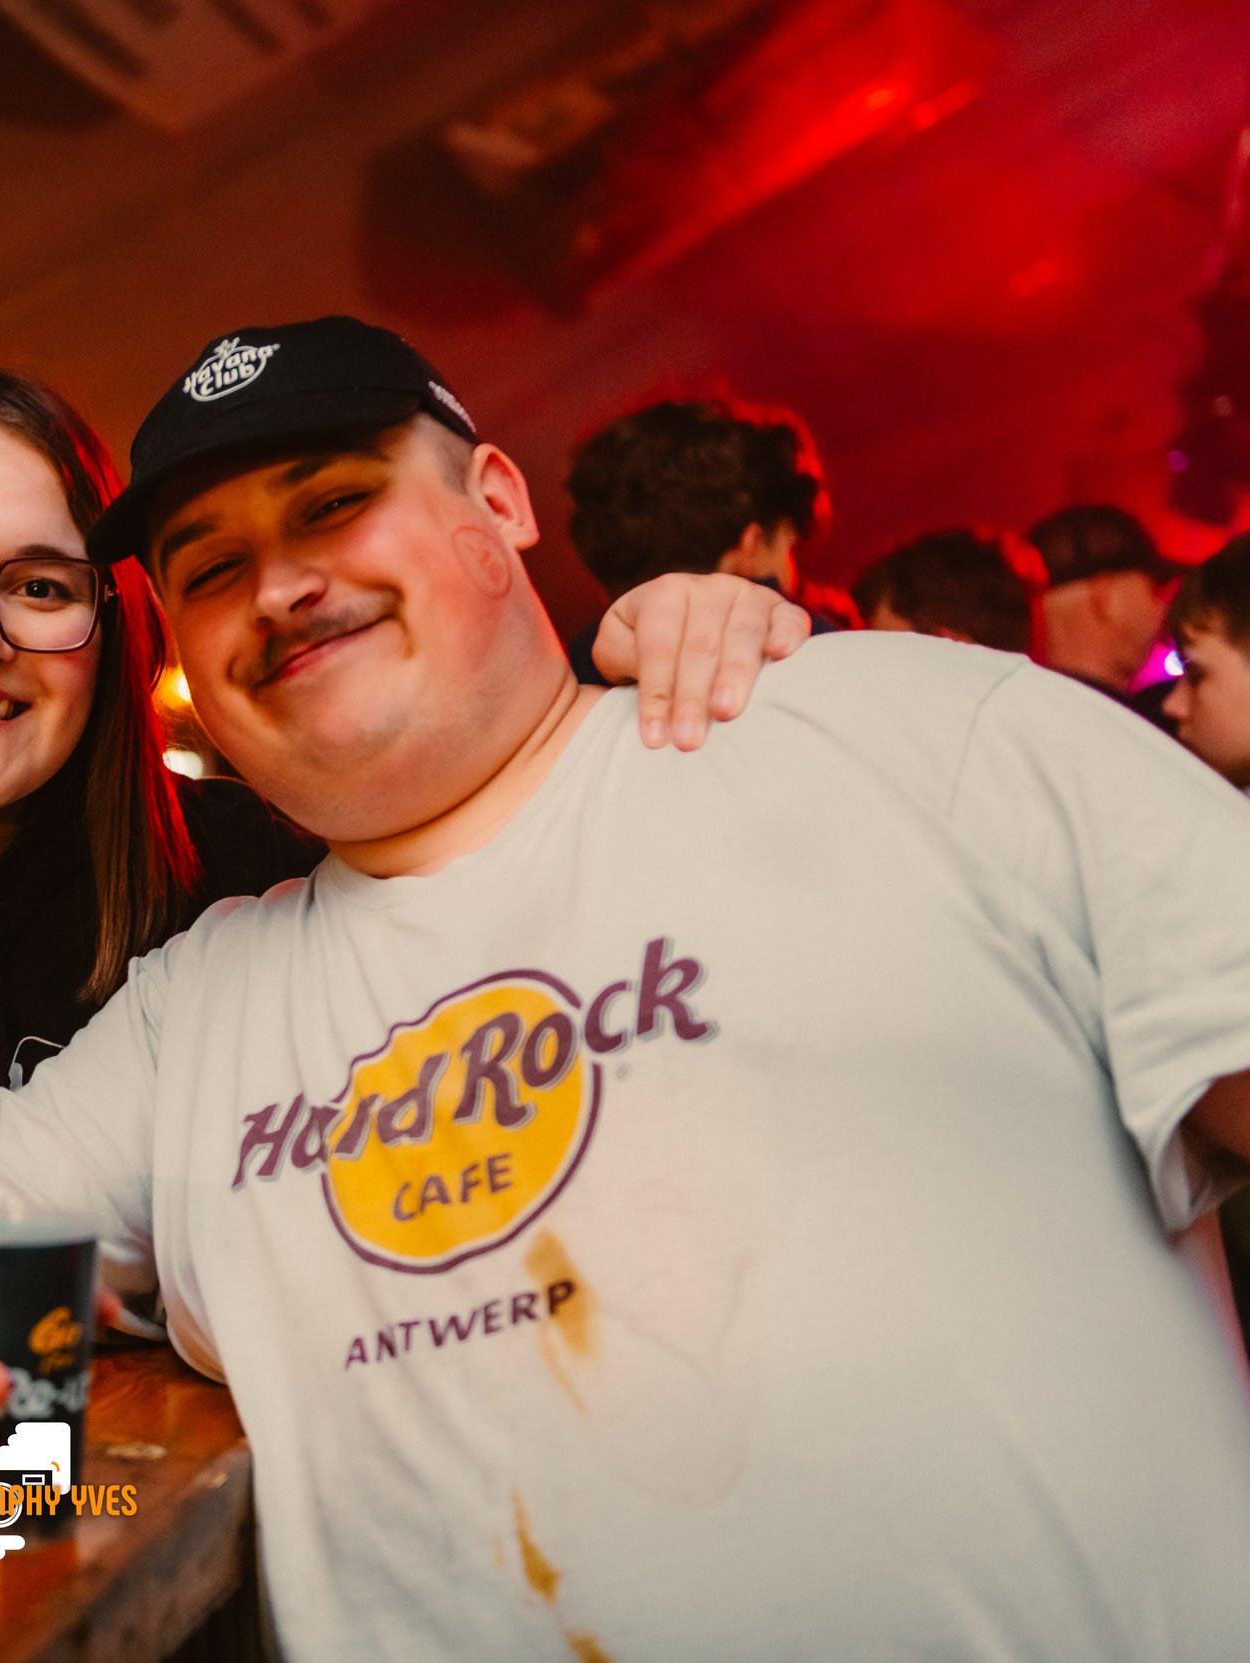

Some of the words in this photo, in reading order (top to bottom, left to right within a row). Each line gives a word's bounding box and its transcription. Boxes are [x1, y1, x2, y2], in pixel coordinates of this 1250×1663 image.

[231, 1050, 450, 1192] Hard
[453, 936, 720, 1128] Rock
[391, 1152, 514, 1223] CAFE
[344, 1279, 578, 1371] ANTWERP
